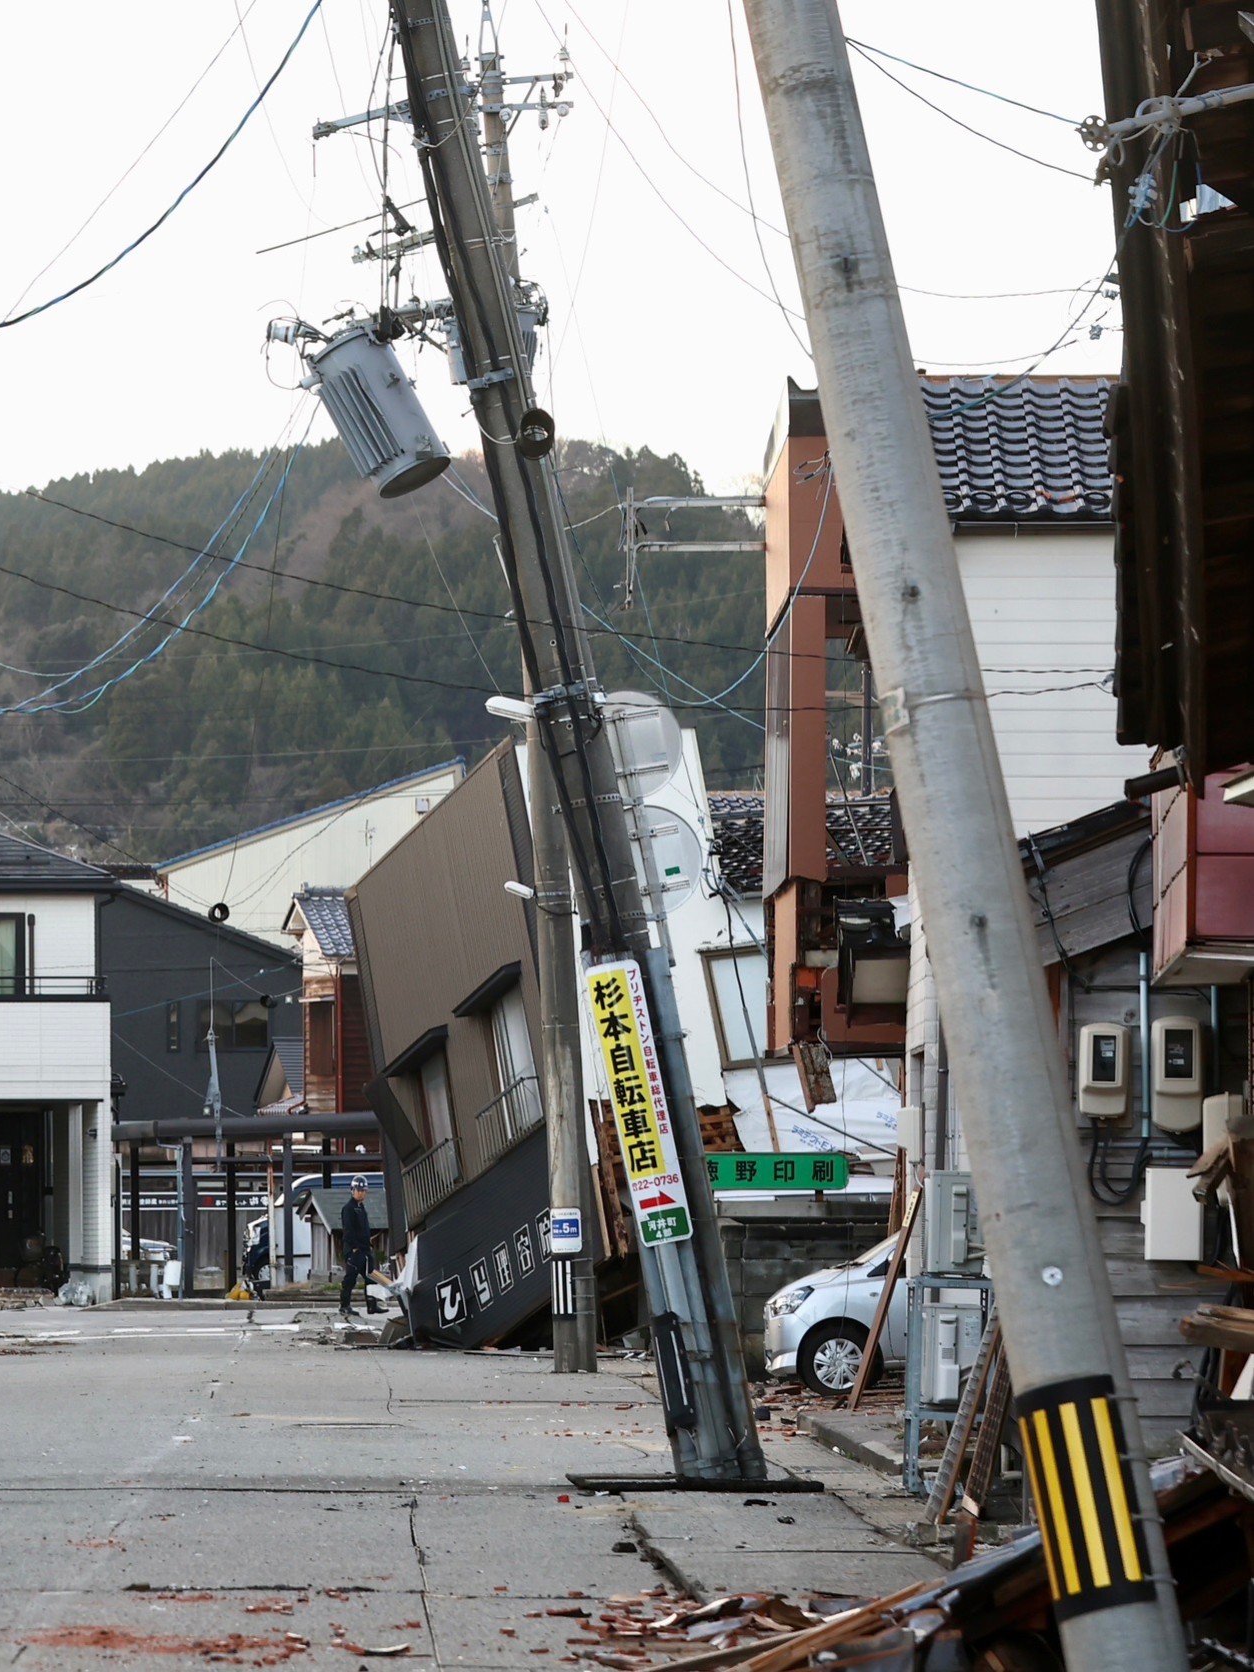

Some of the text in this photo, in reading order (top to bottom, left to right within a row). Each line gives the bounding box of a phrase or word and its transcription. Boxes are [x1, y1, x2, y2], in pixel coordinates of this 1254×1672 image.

[593, 977, 658, 1174] 杉本自転車店
[638, 1173, 679, 1191] 22-0736
[562, 1222, 578, 1234] 5m
[647, 1216, 677, 1232] 河井町
